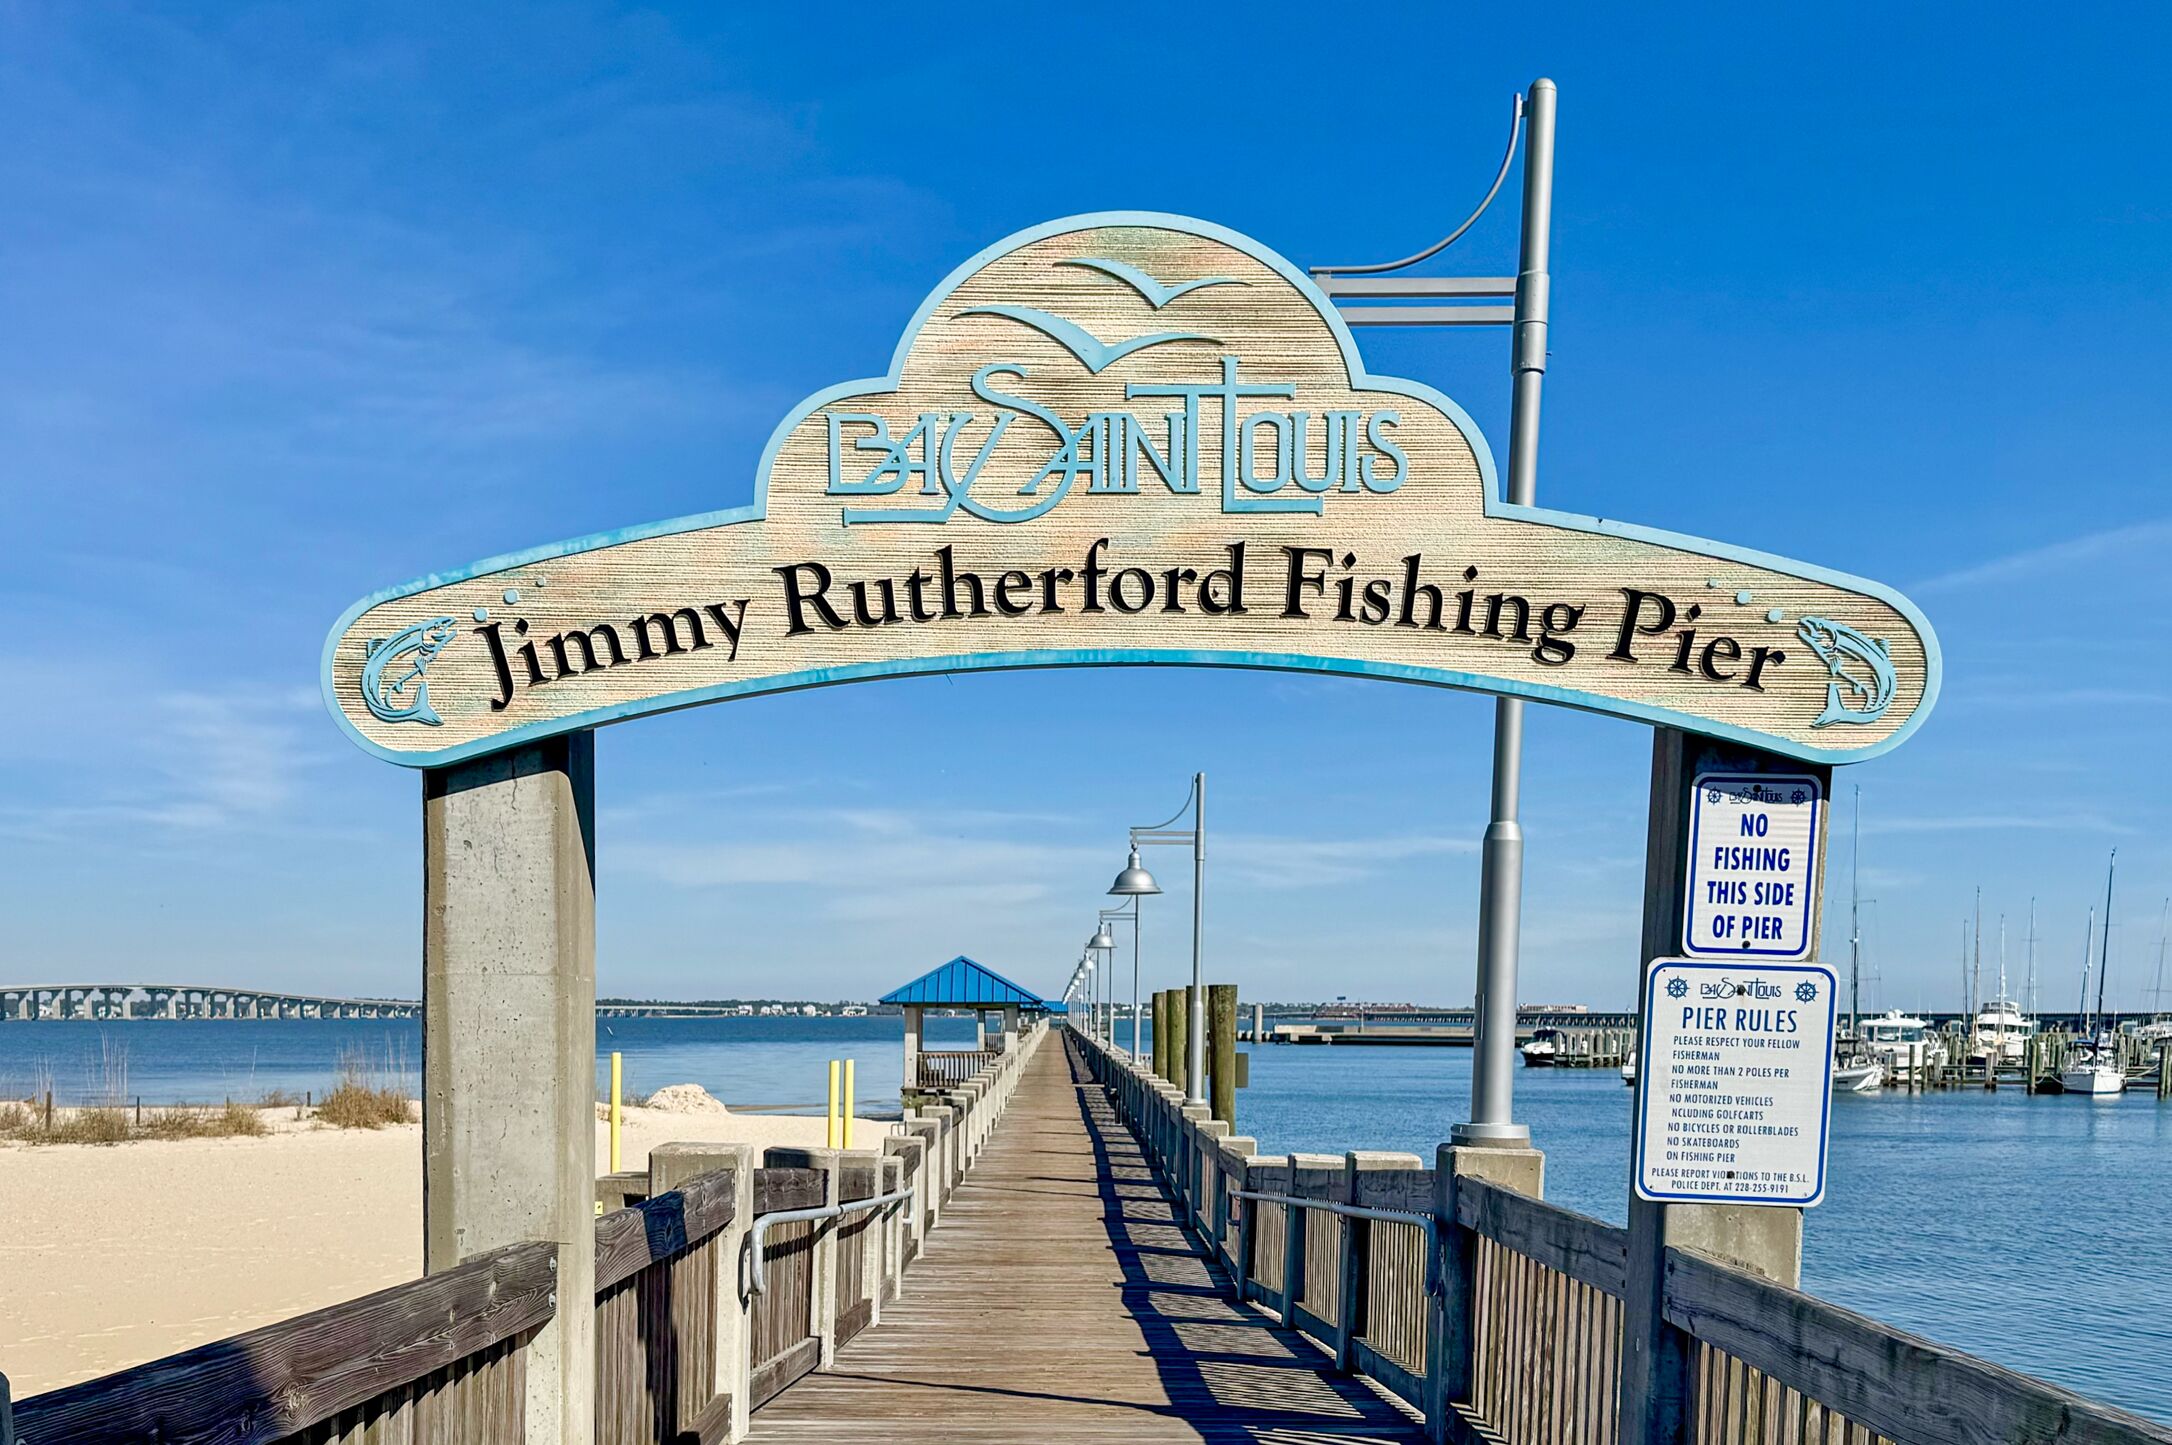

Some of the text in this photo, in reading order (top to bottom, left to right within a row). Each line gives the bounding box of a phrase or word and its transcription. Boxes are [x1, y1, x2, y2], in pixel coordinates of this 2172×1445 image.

[473, 537, 1787, 712] Jimmy Rutherford Fishing Pier
[1740, 813, 1768, 837] NO
[1714, 847, 1790, 871] FISHING
[1707, 881, 1794, 906] THIS SIDE
[1713, 915, 1783, 940] OF PIER
[1682, 1006, 1798, 1033] PIER RULES
[1673, 1035, 1800, 1049] PLEASE RESPECT YOUR FELLOW
[1672, 1050, 1720, 1061] FISHERMAN
[1672, 1064, 1789, 1078] NO MORE THAN 2 POLES PER
[1671, 1079, 1718, 1090] FISHERMAN
[1669, 1093, 1774, 1107] NO MOTORIZED VEHICLES
[1716, 1109, 1764, 1121] GOLFCARTS
[1667, 1122, 1799, 1137] NO BICYCLES OR ROLLERBLADES
[1667, 1137, 1740, 1149] NO SKATEBOARDS
[1666, 1151, 1735, 1163] ON FISHING PIER
[1651, 1167, 1679, 1177] PLEASE
[1681, 1169, 1710, 1179] REPORT
[1712, 1170, 1759, 1181] VIOTIONS
[1761, 1172, 1771, 1181] TO
[1773, 1172, 1787, 1182] THE
[1671, 1179, 1789, 1193] POLICE DEPT. AT 228-255-9191
